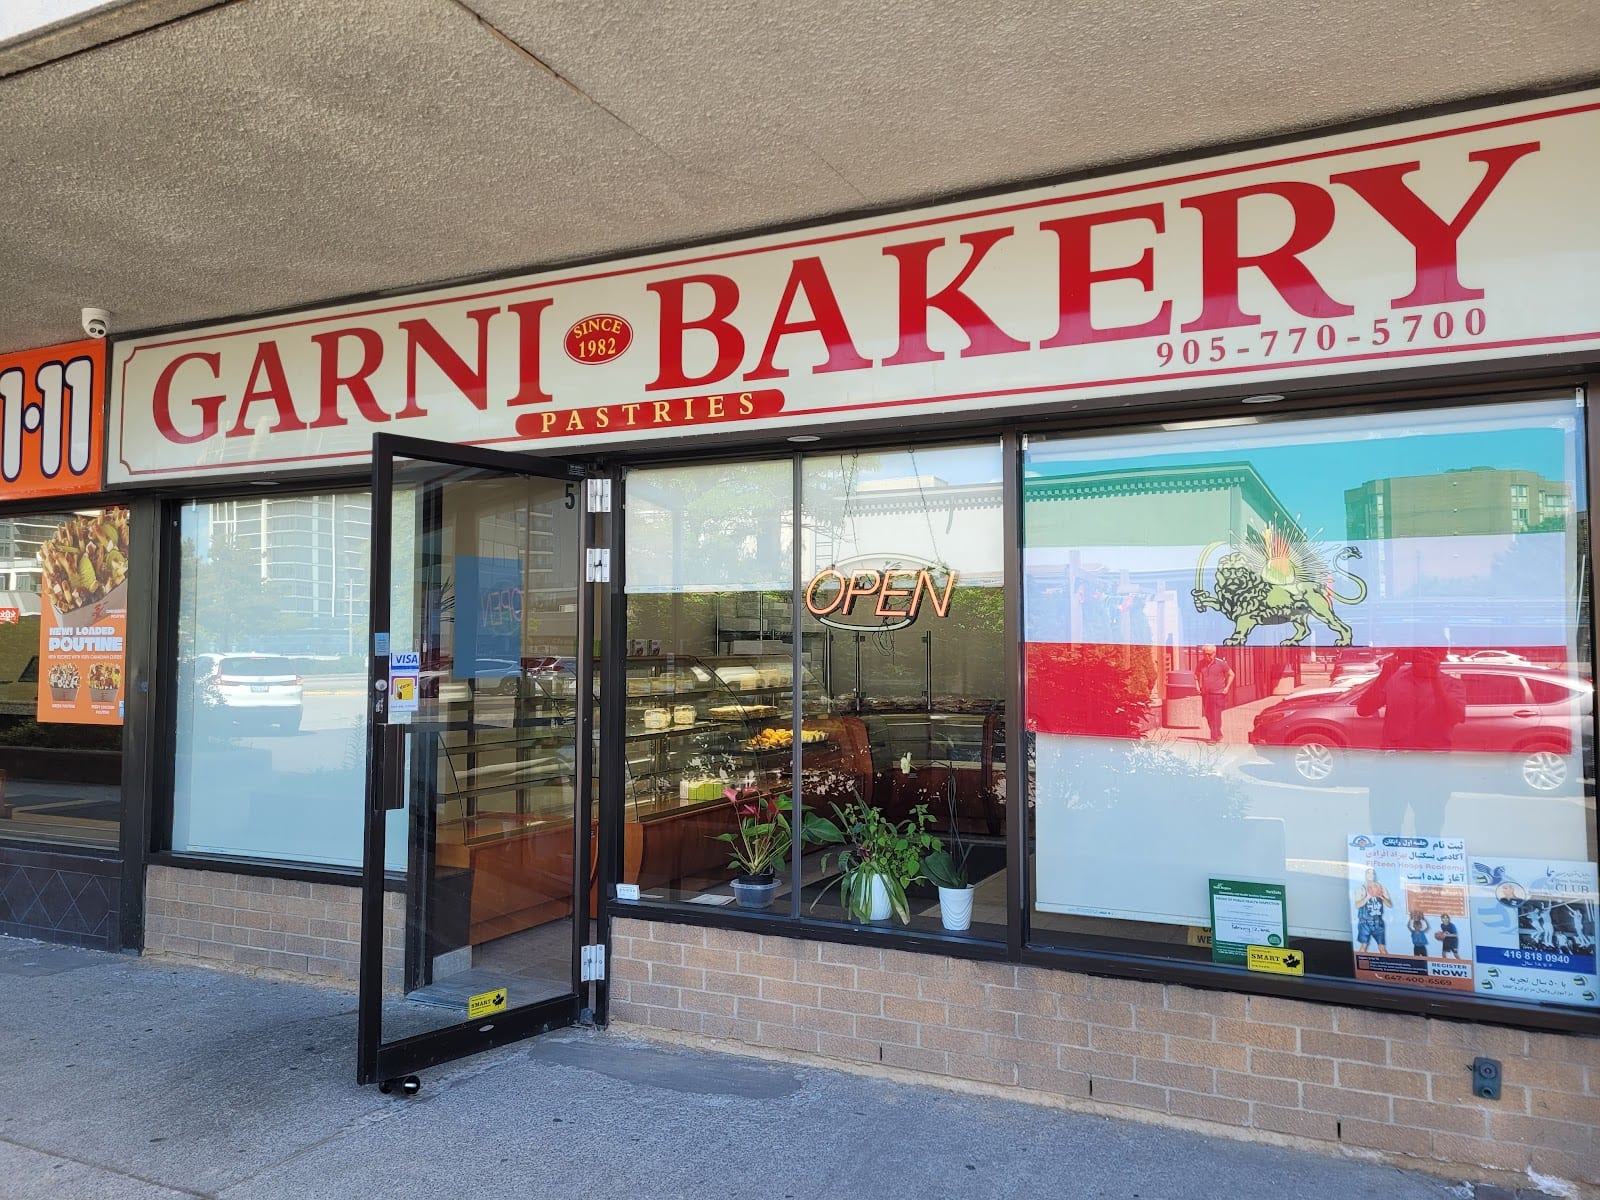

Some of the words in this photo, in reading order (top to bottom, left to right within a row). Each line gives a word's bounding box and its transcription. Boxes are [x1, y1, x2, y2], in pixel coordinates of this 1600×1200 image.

[152, 298, 553, 443] GARNI
[644, 141, 1541, 391] BAKERY
[573, 318, 623, 339] SINCE
[1156, 308, 1486, 367] 905-770-5700
[579, 337, 616, 358] 1982
[541, 393, 754, 433] PASTRIES
[564, 483, 575, 509] 5
[806, 568, 959, 618] OPEN
[76, 626, 115, 636] LOADED
[48, 636, 123, 652] POUTINE
[396, 654, 418, 664] VISA
[1556, 883, 1590, 894] CLUB
[1251, 953, 1280, 961] SMART
[1504, 950, 1522, 959] 416
[1525, 951, 1543, 961] 818
[1545, 954, 1570, 964] 0940
[1432, 962, 1467, 970] REGISTER
[1432, 969, 1468, 978] NOW!
[471, 999, 491, 1009] SMART
